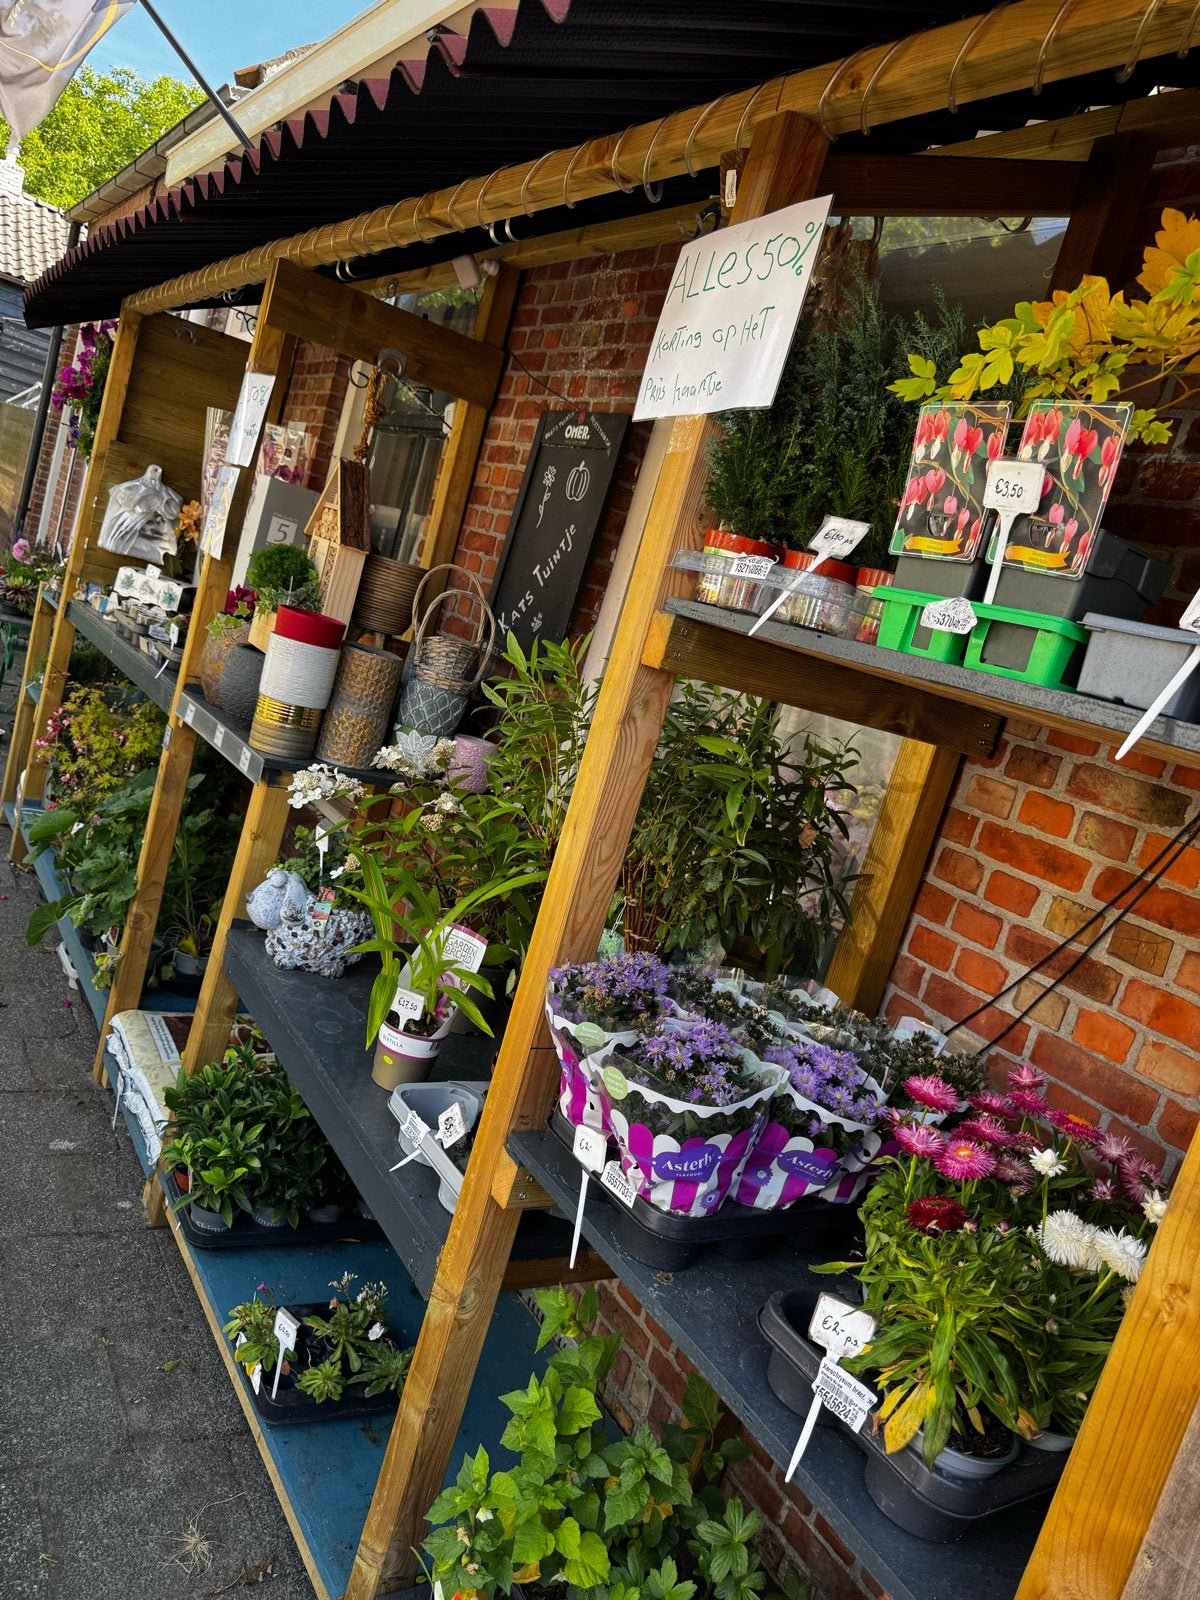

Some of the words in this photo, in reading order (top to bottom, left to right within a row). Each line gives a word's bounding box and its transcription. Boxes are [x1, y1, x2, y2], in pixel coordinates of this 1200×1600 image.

[994, 478, 1024, 498] €3,50
[273, 523, 290, 543] 5
[498, 590, 534, 635] KATS
[444, 945, 472, 965] ORCHID
[447, 936, 477, 957] GARDEN
[661, 1152, 715, 1172] Asterly
[786, 1154, 834, 1180] Asterly
